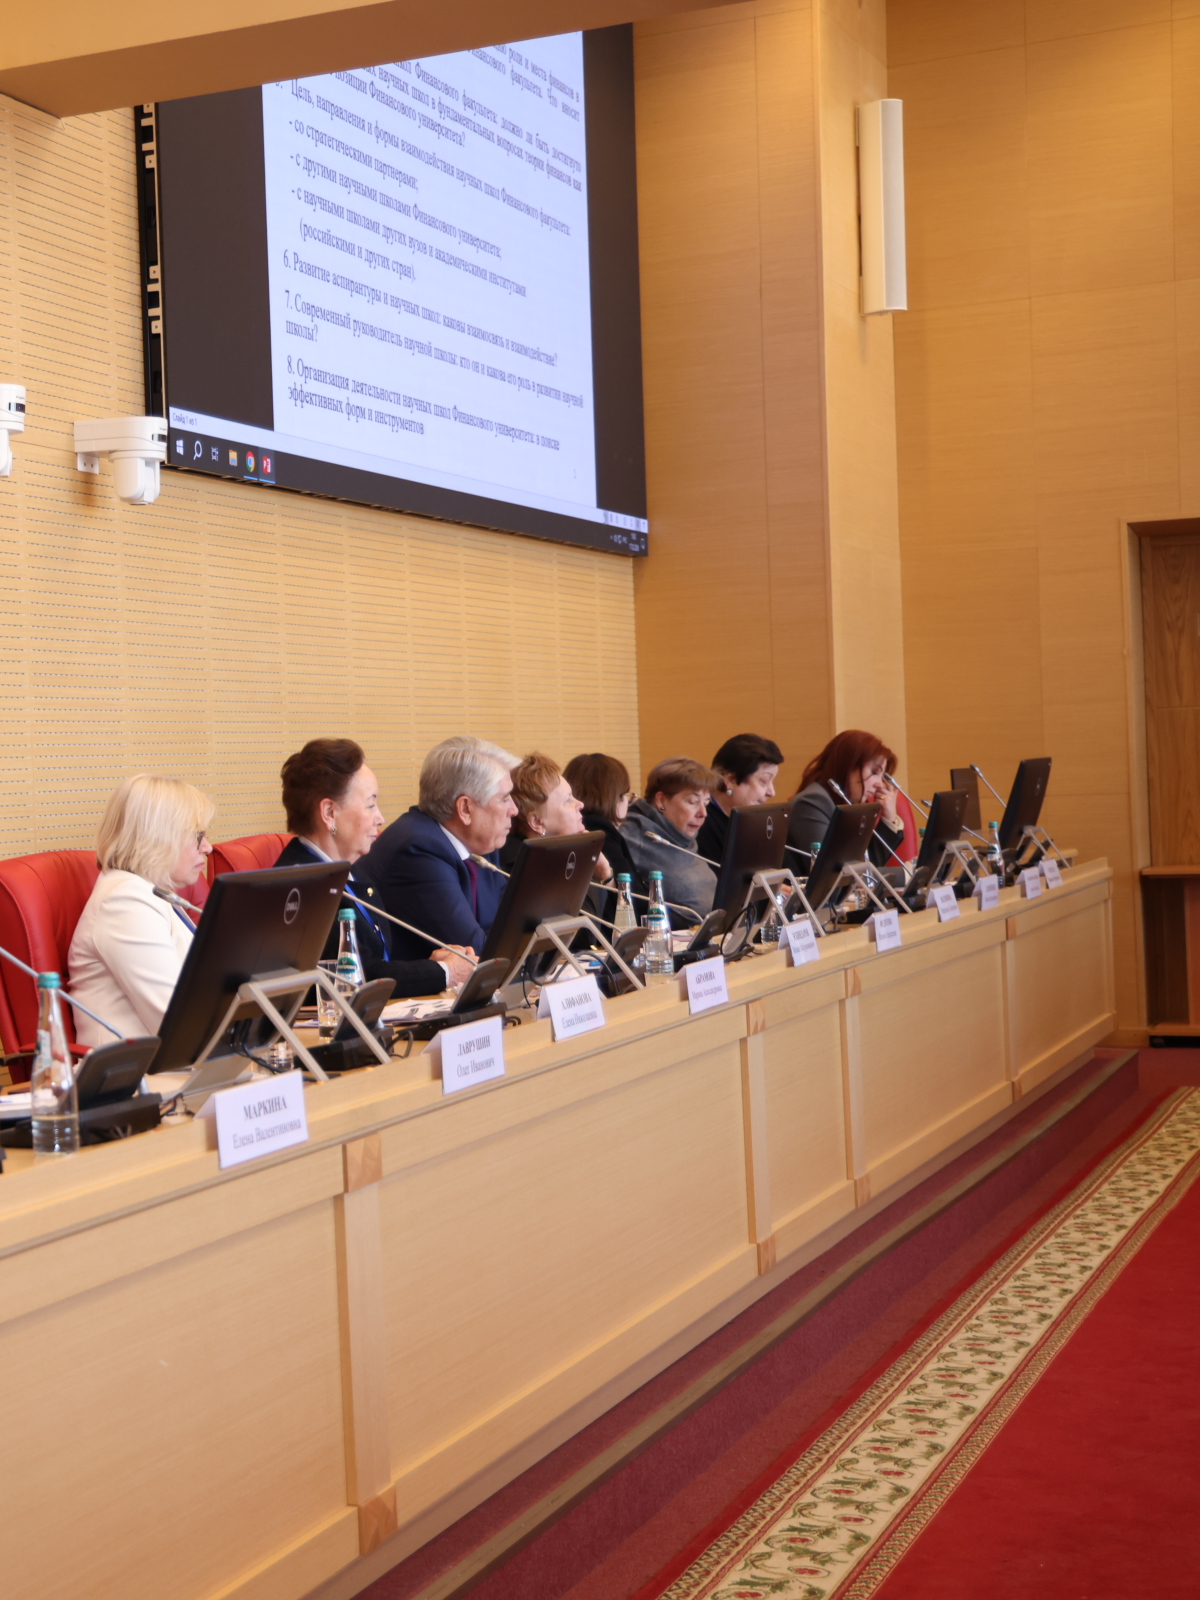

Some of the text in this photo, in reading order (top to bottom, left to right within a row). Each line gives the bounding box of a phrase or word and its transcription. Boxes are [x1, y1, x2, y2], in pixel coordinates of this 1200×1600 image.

[414, 62, 459, 101] Финансового
[468, 49, 506, 75] инансового
[369, 80, 416, 121] Финансового
[418, 112, 466, 148] университета?
[378, 67, 410, 96] научных
[412, 86, 430, 106] школ
[432, 98, 436, 110] в
[438, 96, 495, 144] фундаментальных
[496, 135, 524, 160] вопросах
[291, 79, 314, 108] Цель,
[316, 94, 366, 132] направления
[368, 122, 372, 135] и
[374, 120, 400, 148] формы
[400, 140, 454, 178] взаимодействия
[456, 168, 482, 192] научных
[484, 182, 500, 200] школ
[501, 187, 538, 220] Финансового
[294, 119, 304, 135] со
[306, 124, 372, 168] стратегическими
[374, 158, 418, 192] партнерами;
[296, 153, 300, 166] с
[302, 156, 337, 184] другими
[338, 172, 378, 202] научными
[379, 192, 411, 218] школами
[412, 203, 456, 238] Финансового
[296, 187, 302, 200] с
[304, 190, 344, 220] научными
[346, 208, 380, 235] школами
[382, 224, 407, 247] других
[408, 236, 428, 254] вузов
[428, 244, 434, 258] и
[434, 248, 488, 282] академическими
[488, 271, 526, 298] институтами
[300, 217, 356, 257] (российскими
[358, 246, 362, 259] и
[364, 248, 390, 270] других
[283, 248, 291, 268] 6.
[293, 252, 330, 283] Развитие
[332, 272, 382, 305] аспирантуры
[384, 293, 388, 305] и
[390, 294, 420, 317] научных
[443, 315, 466, 334] каковы
[467, 324, 504, 348] взаимосвязь
[506, 338, 510, 350] и
[285, 290, 292, 310] 7.
[294, 293, 351, 330] Современный
[353, 318, 402, 347] руководитель
[404, 336, 432, 358] научной
[460, 356, 470, 370] кто
[472, 361, 480, 374] он
[481, 364, 485, 376] и
[486, 365, 506, 382] какова
[518, 376, 531, 392] роль
[286, 320, 318, 342] школы?
[287, 354, 294, 375] 8.
[296, 358, 350, 391] Организация
[351, 379, 401, 406] деятельности
[402, 394, 432, 415] научных
[434, 404, 450, 420] школ
[452, 405, 494, 432] Финансового
[288, 382, 424, 435] эффективных форм и инструментов
[456, 1056, 495, 1078] Олег Иванович
[457, 1035, 491, 1056] ЛАВРУШИН
[232, 1118, 302, 1149] Елена Валентиновна
[243, 1095, 288, 1121] МАРКИНА
